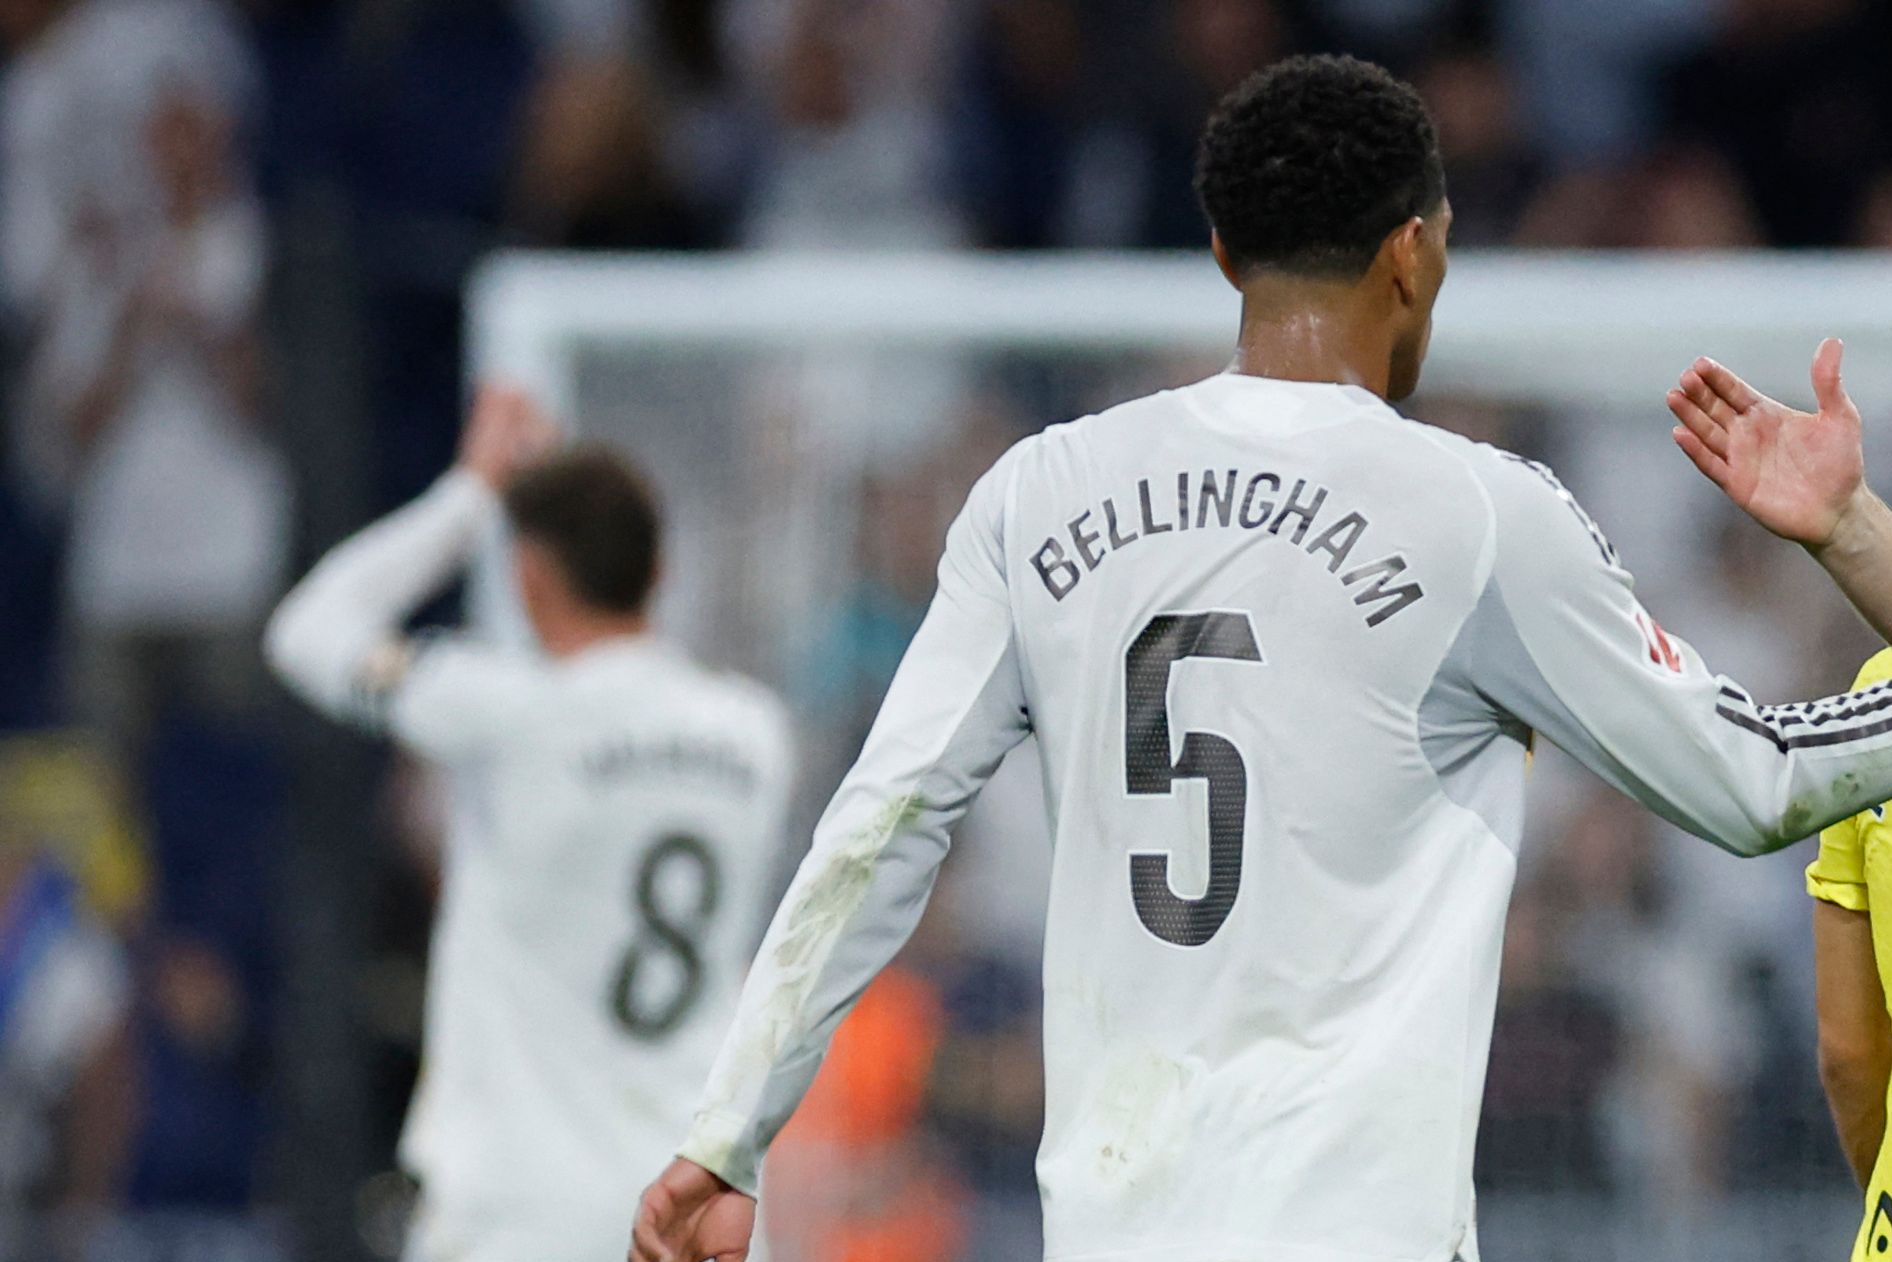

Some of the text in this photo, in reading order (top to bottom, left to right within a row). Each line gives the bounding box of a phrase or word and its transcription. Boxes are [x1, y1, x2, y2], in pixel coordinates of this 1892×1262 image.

[1030, 468, 1425, 629] BELLINGHAM
[1124, 610, 1263, 947] 5
[609, 832, 722, 1040] 8
